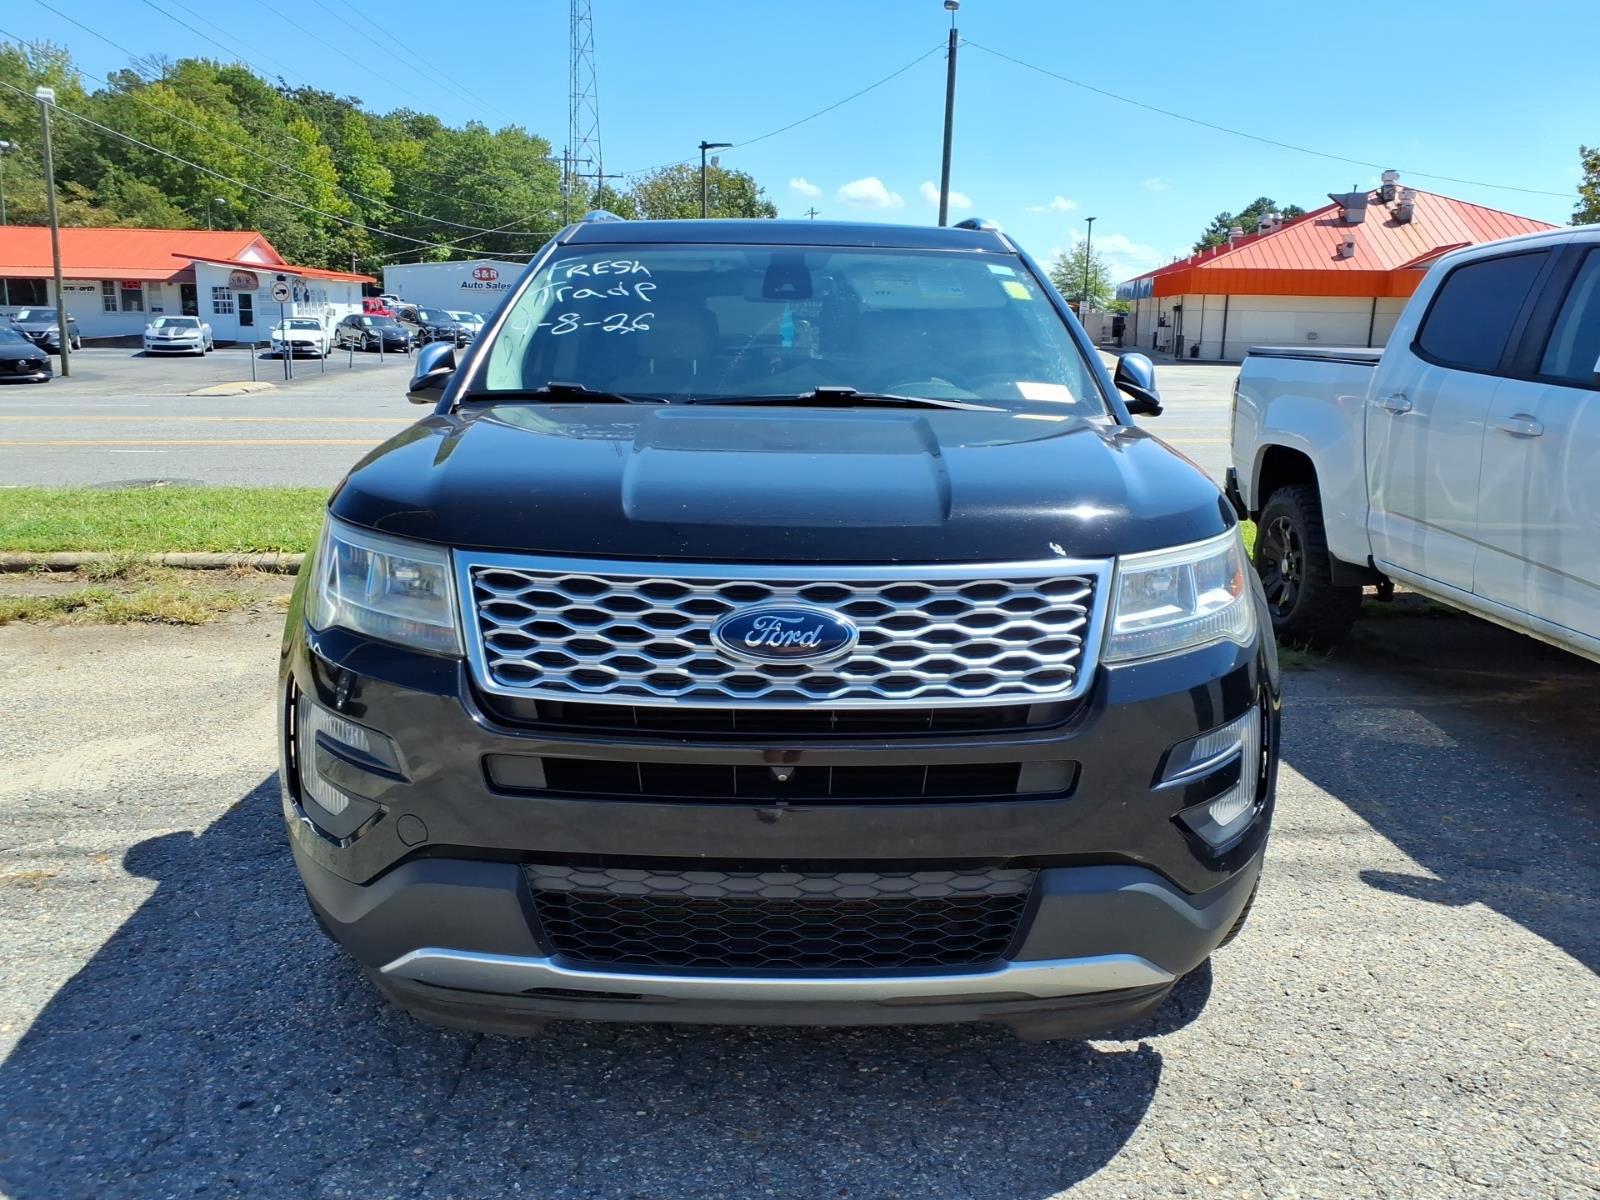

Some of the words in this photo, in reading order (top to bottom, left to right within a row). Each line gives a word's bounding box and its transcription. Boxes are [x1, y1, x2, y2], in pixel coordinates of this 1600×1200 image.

[473, 270, 498, 279] S&R
[460, 281, 483, 289] Auto
[486, 281, 512, 290] Sales
[744, 615, 824, 647] Ford
